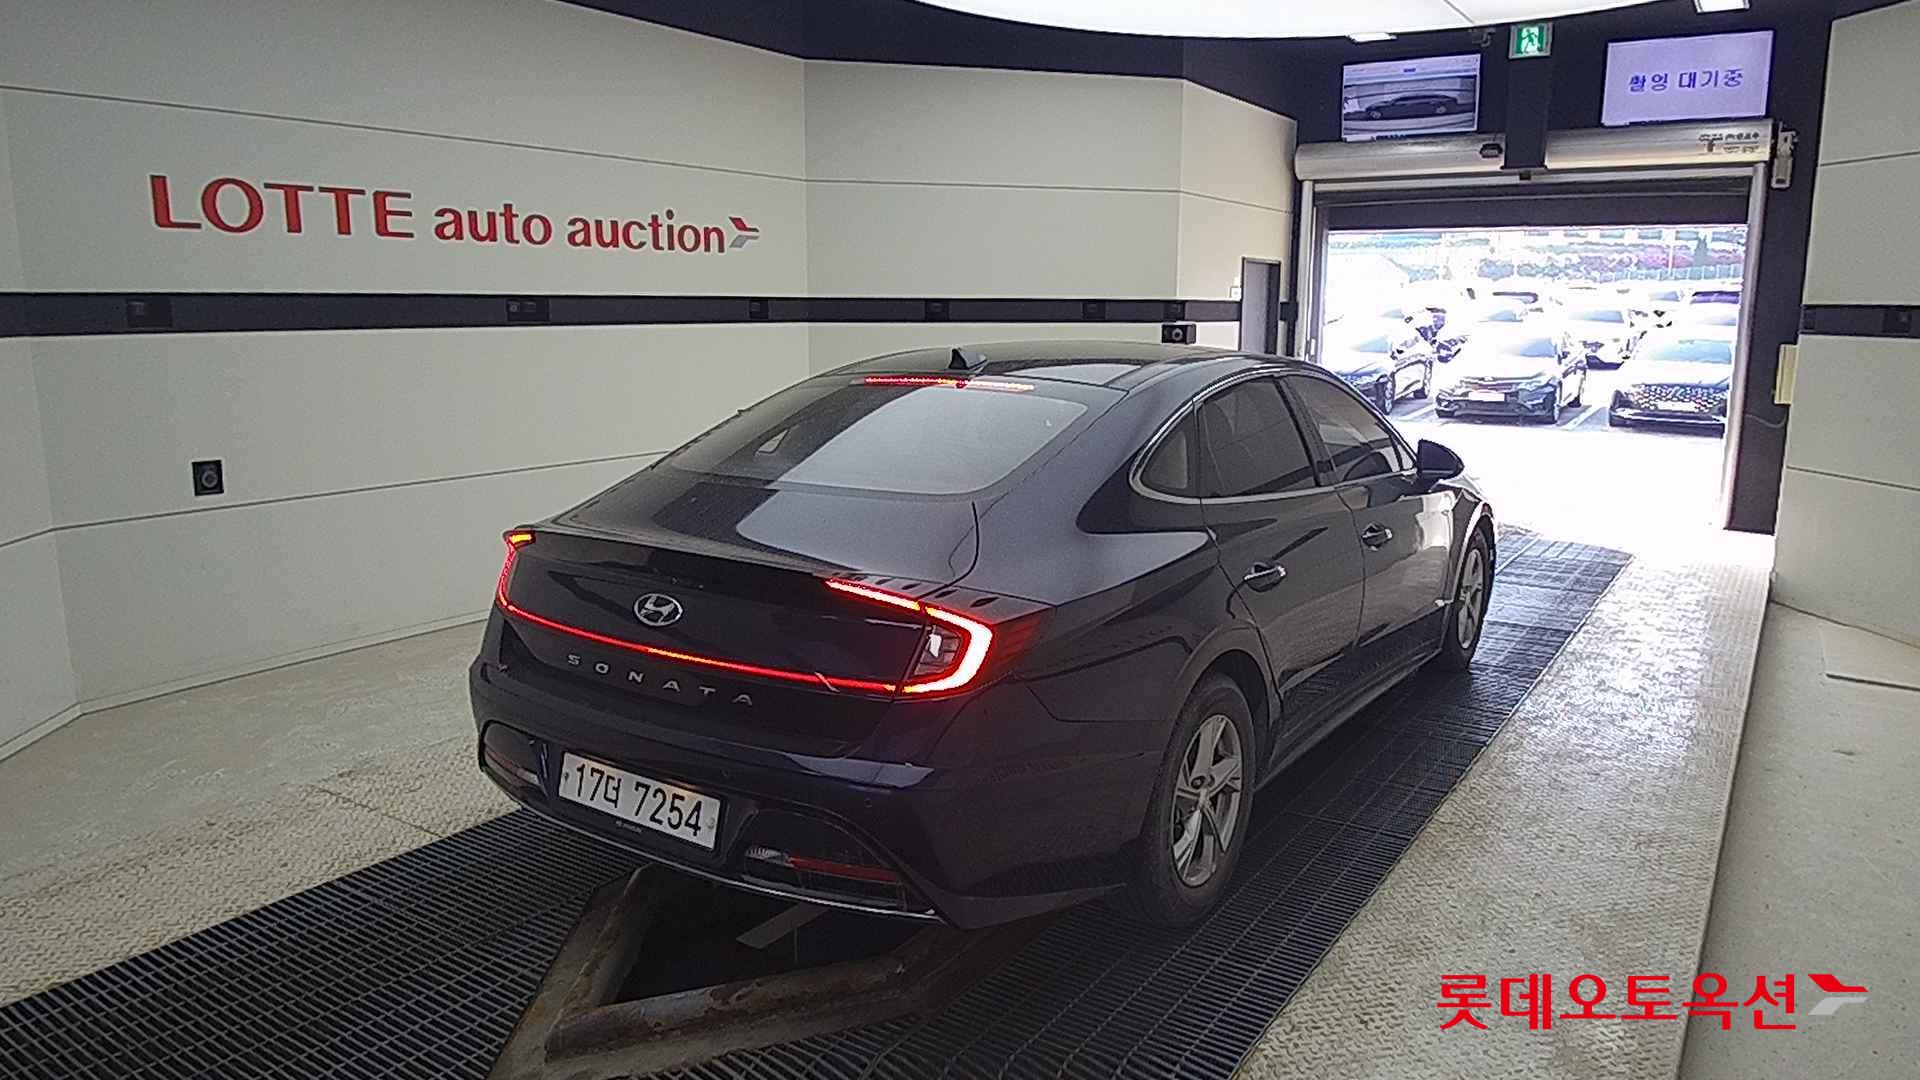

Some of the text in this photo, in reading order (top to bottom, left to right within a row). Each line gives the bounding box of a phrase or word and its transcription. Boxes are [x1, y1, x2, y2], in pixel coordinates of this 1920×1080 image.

[1678, 68, 1744, 89] 대기중
[150, 174, 725, 253] LOTTE auto auction
[567, 653, 753, 706] SONATA
[576, 763, 702, 836] 17더 7254
